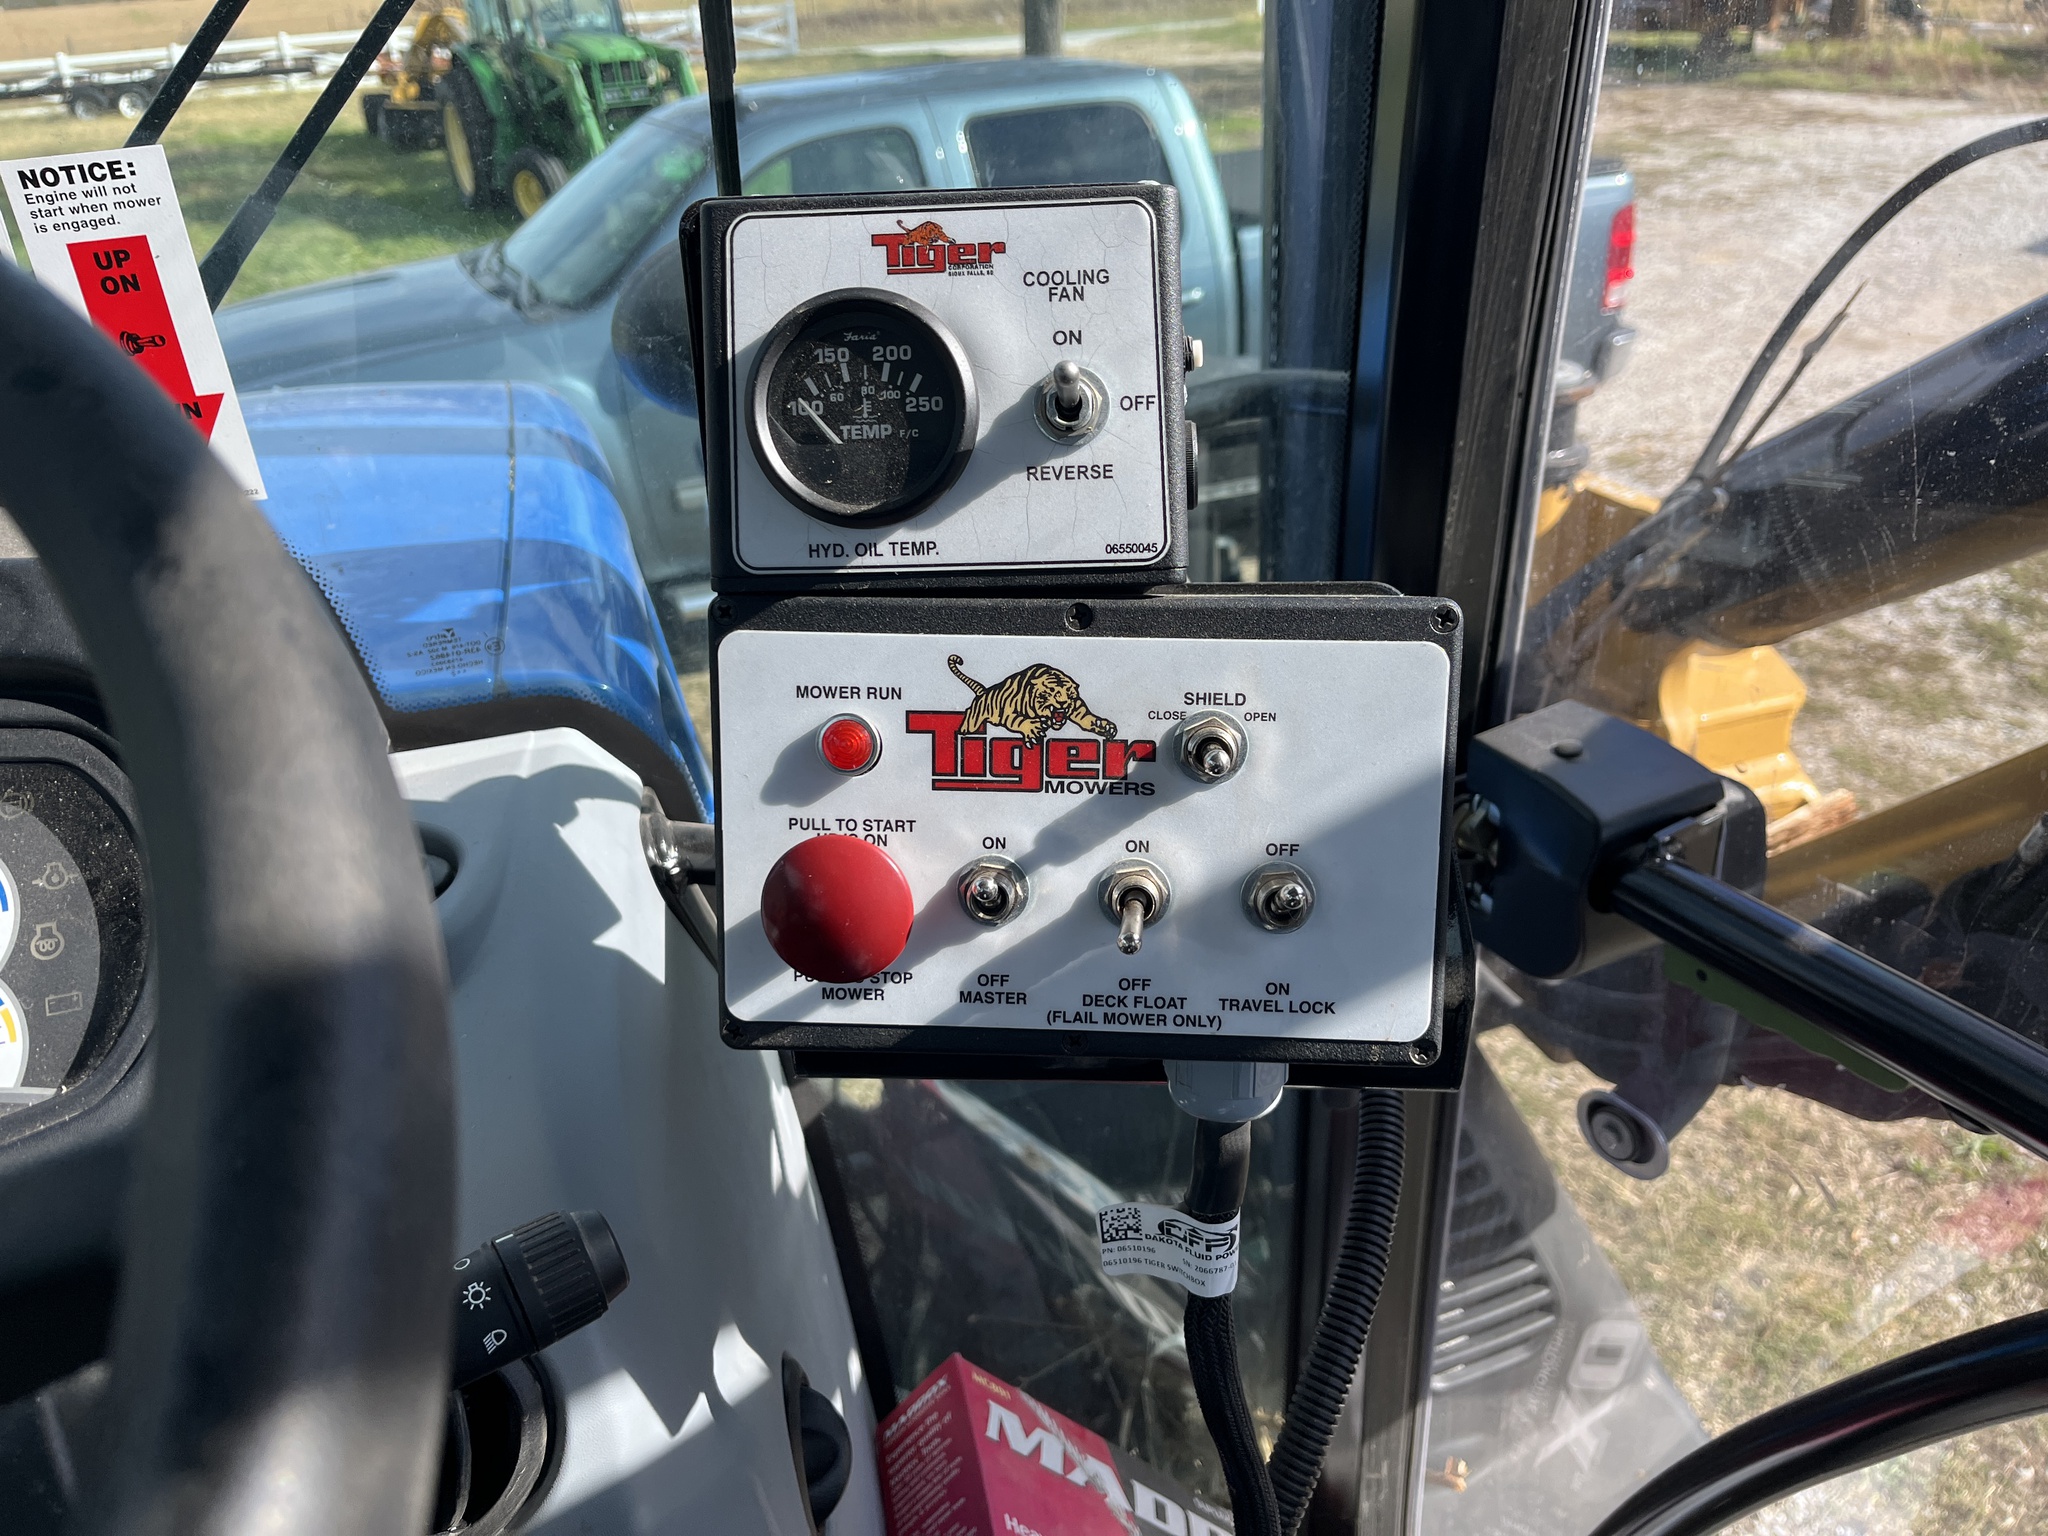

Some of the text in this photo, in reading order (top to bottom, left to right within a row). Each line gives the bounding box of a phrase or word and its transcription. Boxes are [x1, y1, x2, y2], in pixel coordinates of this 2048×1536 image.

[17, 160, 137, 190] NOTICE:
[24, 183, 137, 205] Engine will not
[30, 196, 161, 219] start when mower
[33, 215, 121, 234] is engaged.
[93, 249, 131, 270] UP
[871, 233, 1006, 275] Tiger
[100, 273, 141, 295] ON
[1022, 269, 1110, 287] COOLING
[1047, 286, 1085, 303] FAN
[1052, 330, 1082, 346] ON
[814, 345, 912, 363] 150 200
[830, 386, 901, 402] 60 80 100
[788, 396, 943, 416] 100 250
[1120, 395, 1157, 411] OFF
[839, 424, 919, 440] TEMP F/C
[1026, 464, 1114, 481] REVERSE
[808, 541, 939, 559] HYD. OIL TEMP.
[1105, 542, 1158, 555] 06550045
[796, 685, 902, 700] MOWER RUN
[1183, 692, 1247, 706] SHIELD
[1148, 710, 1276, 723] CLOSE OPEN
[905, 710, 1157, 792] Tiger
[1044, 781, 1156, 796] MOWERS
[788, 818, 916, 833] PULL TO START
[864, 833, 888, 847] ON
[982, 837, 1006, 850] ON
[1125, 840, 1149, 853] ON
[1265, 843, 1299, 856] OFF
[870, 971, 913, 984] STOP
[977, 974, 1010, 988] OFF
[1118, 978, 1151, 991] OFF
[822, 987, 885, 1001] MOWER
[1265, 982, 1290, 995] ON
[959, 990, 1027, 1005] MASTER
[1082, 994, 1187, 1010] DECK FLOAT
[1219, 998, 1336, 1015] TRAVEL LOCK
[1046, 1010, 1223, 1031] (FLAIL MOWER ONLY)
[1117, 1245, 1156, 1254] 06510196
[1144, 1233, 1184, 1250] DAKOTA
[1185, 1246, 1213, 1261] FLUID
[1182, 1258, 1193, 1268] SN:
[1103, 1257, 1206, 1287] 06510196 TIGER SWITCHBOX
